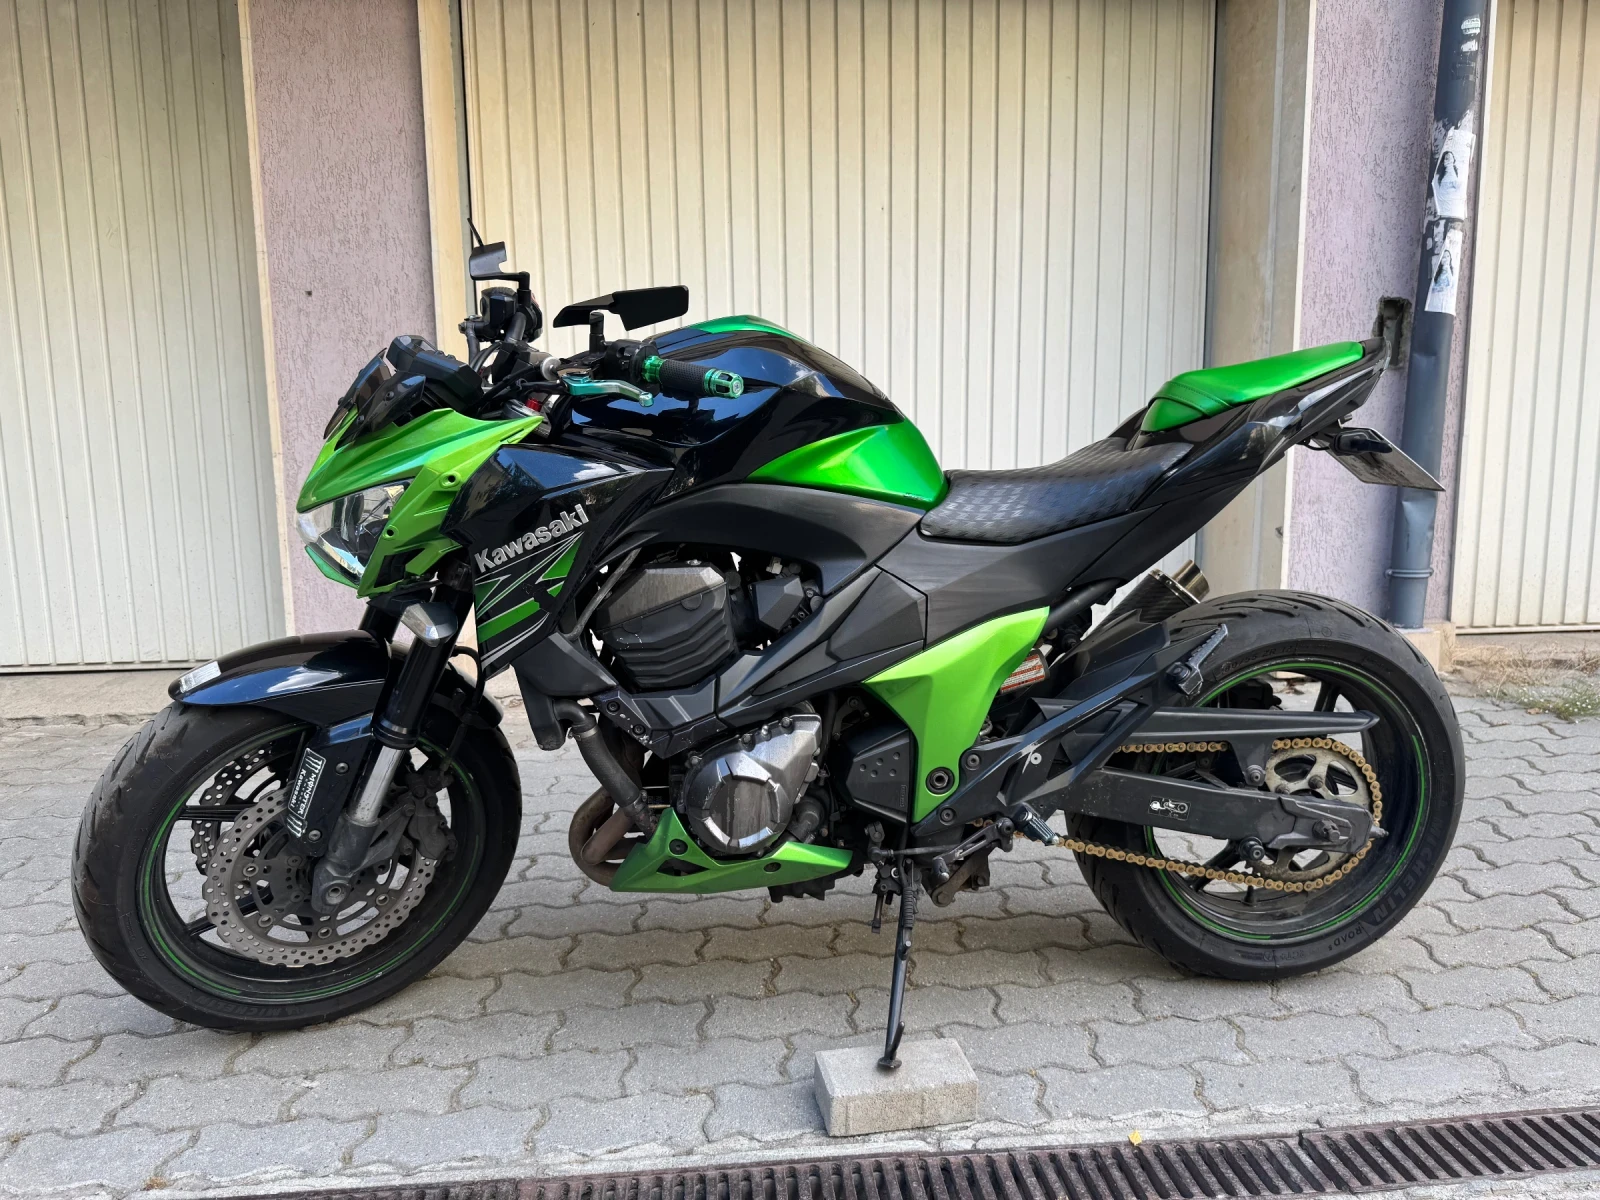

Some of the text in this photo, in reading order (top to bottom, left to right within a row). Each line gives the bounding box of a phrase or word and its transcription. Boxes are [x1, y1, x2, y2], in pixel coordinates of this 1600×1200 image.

[474, 503, 589, 573] Kawasaki
[1372, 816, 1443, 922] MICHELIN
[1334, 927, 1363, 946] ROAD
